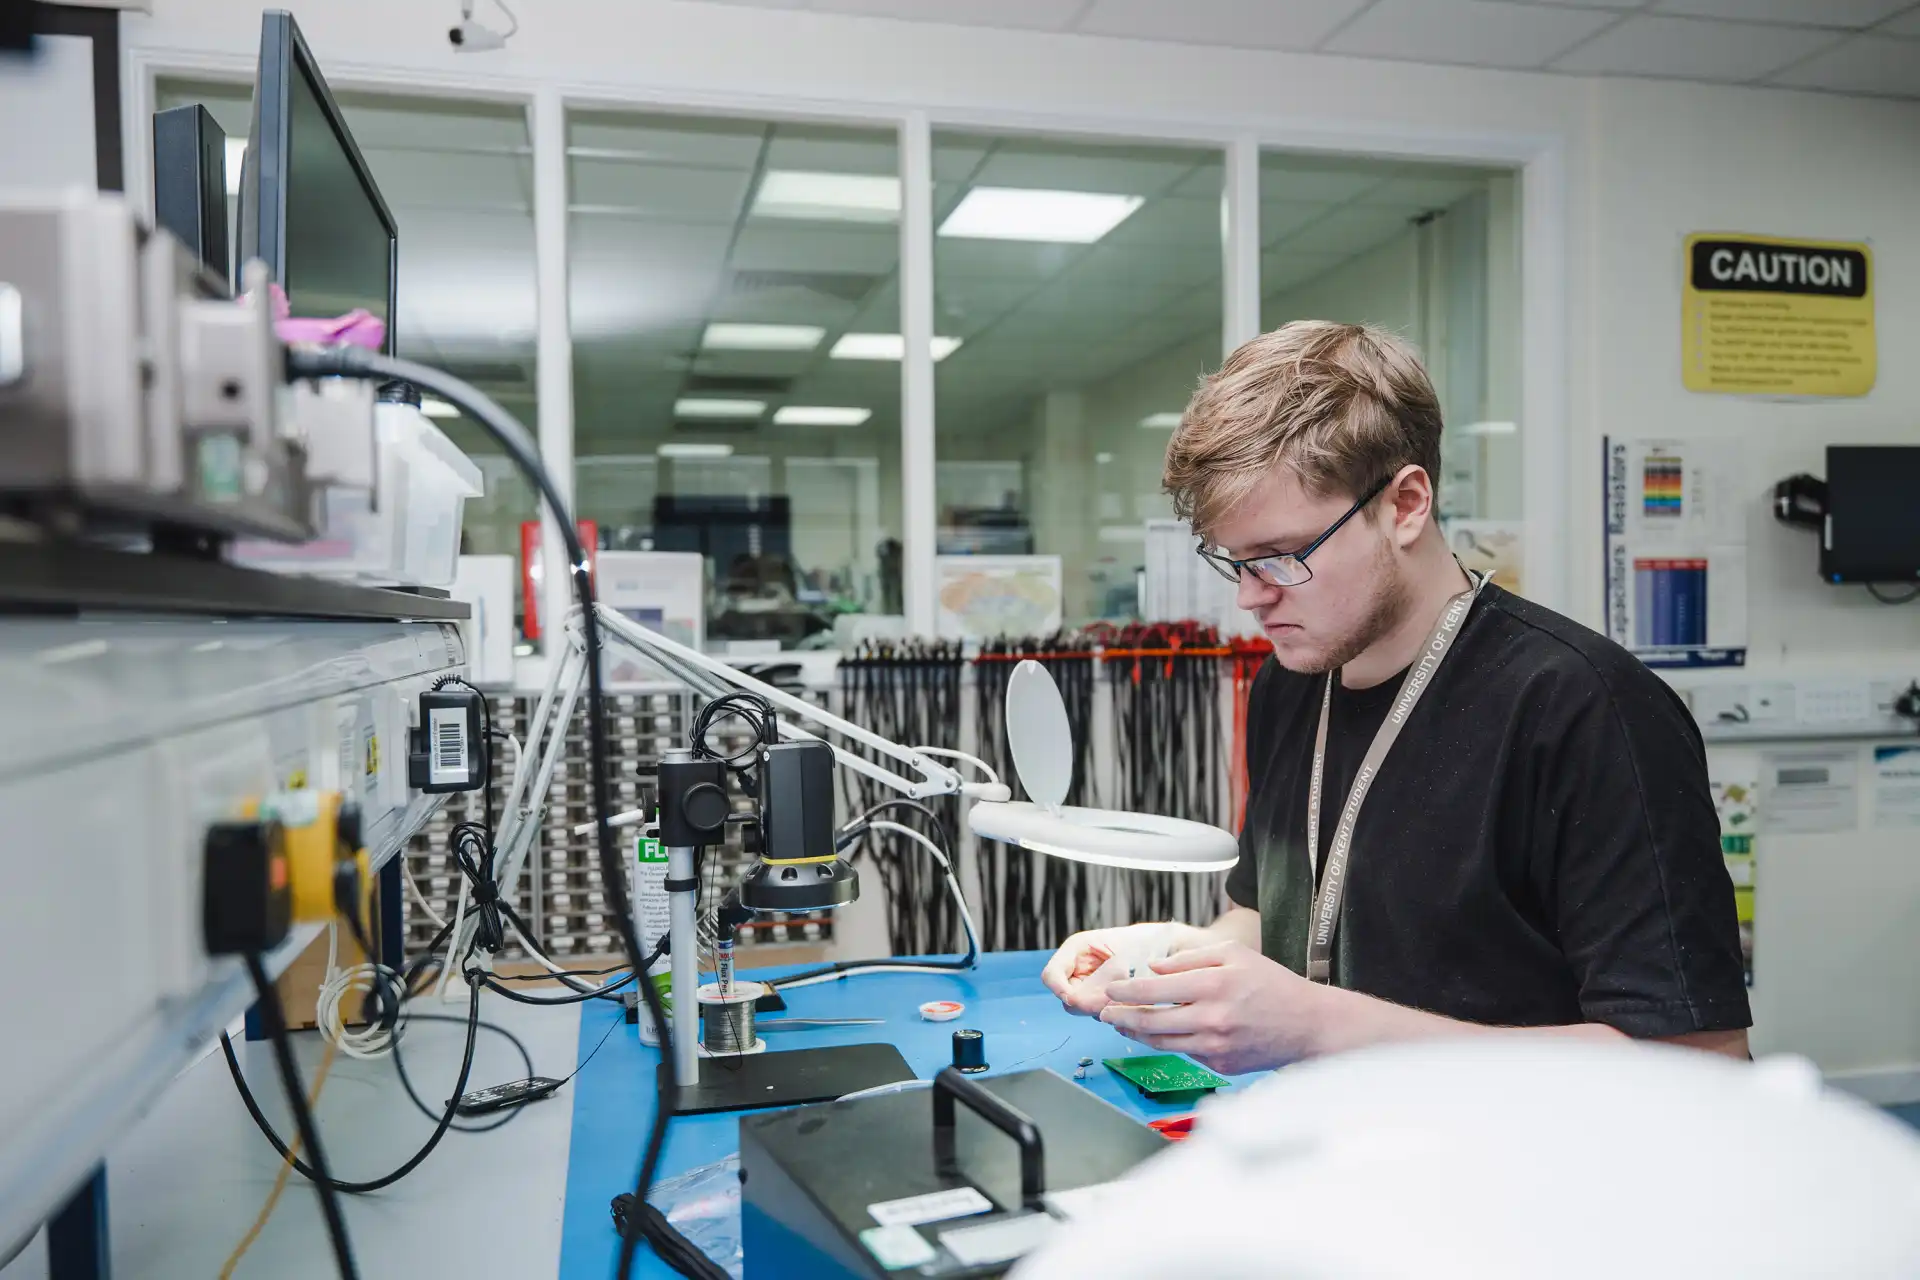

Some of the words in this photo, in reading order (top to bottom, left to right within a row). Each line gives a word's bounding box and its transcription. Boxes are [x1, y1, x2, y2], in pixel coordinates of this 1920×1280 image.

[1710, 249, 1852, 288] CAUTION
[1391, 650, 1437, 724] UNIVERSITY
[1431, 631, 1448, 651] OF
[1442, 599, 1466, 632] KENT
[1311, 751, 1322, 810] STUDENT
[1345, 763, 1373, 822] STUDENT
[1335, 822, 1350, 858] KENT
[1330, 858, 1342, 876] OF
[1315, 876, 1339, 945] UNIVERSITY
[720, 963, 728, 978] Flux
[721, 979, 729, 993] Pen
